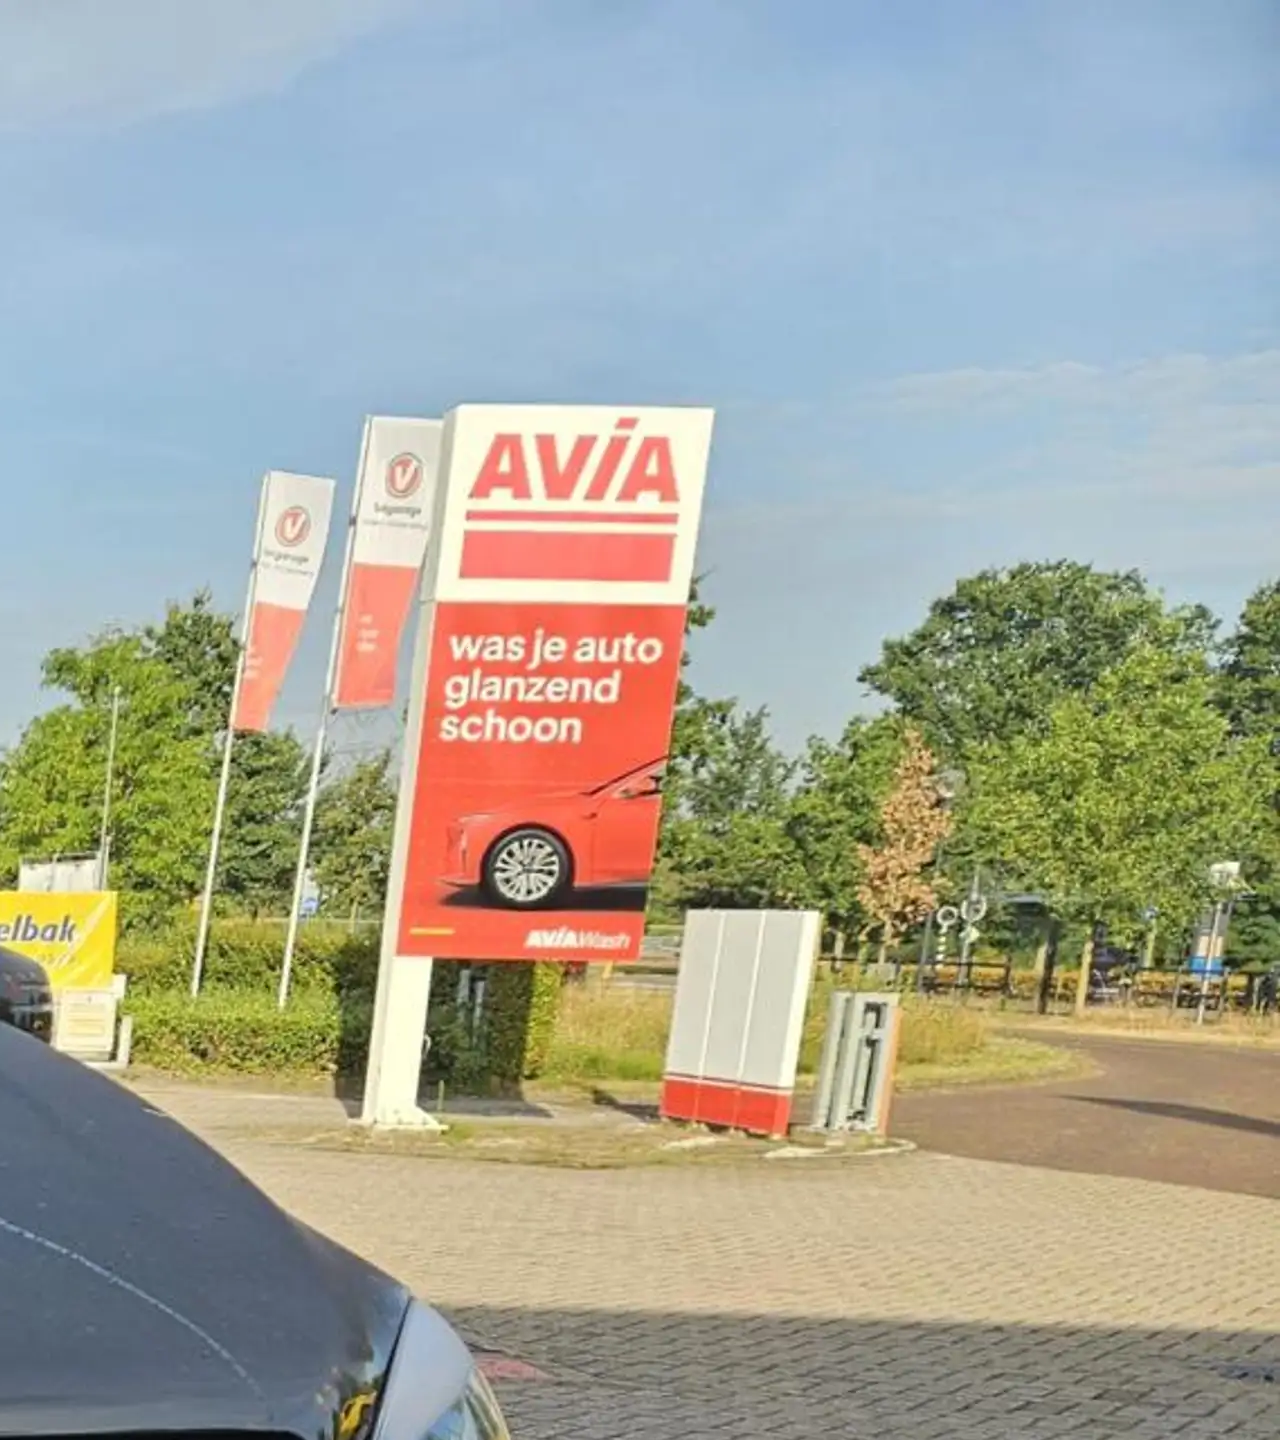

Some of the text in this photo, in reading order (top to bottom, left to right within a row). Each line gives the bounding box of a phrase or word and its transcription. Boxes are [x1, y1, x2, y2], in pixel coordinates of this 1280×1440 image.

[449, 627, 663, 670] was je auto
[444, 668, 621, 710] glanzend
[440, 709, 582, 744] schoon
